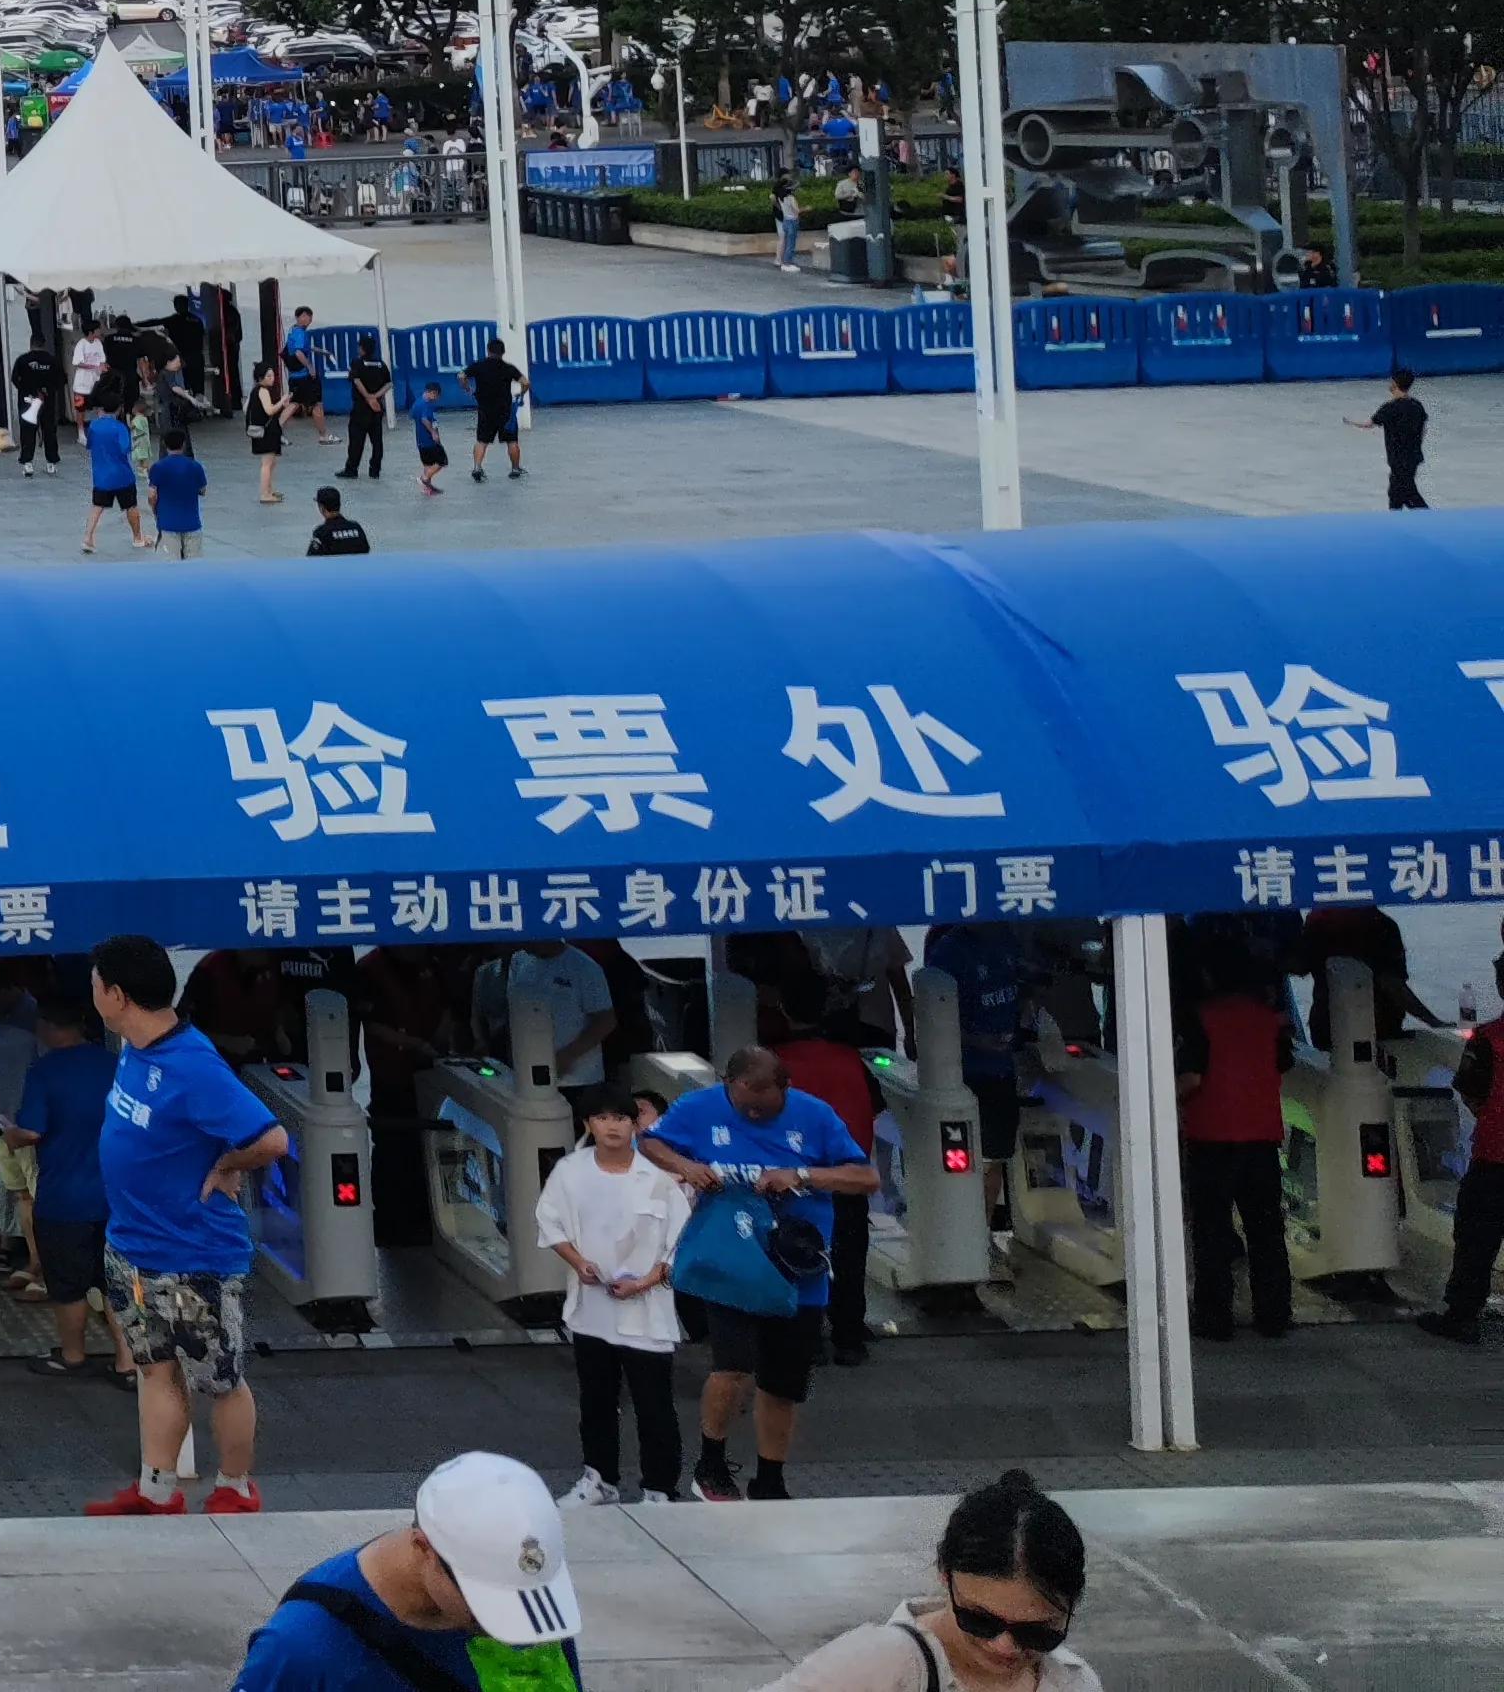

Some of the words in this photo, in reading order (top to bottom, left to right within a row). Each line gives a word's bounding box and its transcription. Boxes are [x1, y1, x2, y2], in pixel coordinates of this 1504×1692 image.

[206, 684, 1007, 841] 验票处
[1175, 659, 1504, 808] 验
[240, 855, 1057, 939] 请主动出示身份证、门票
